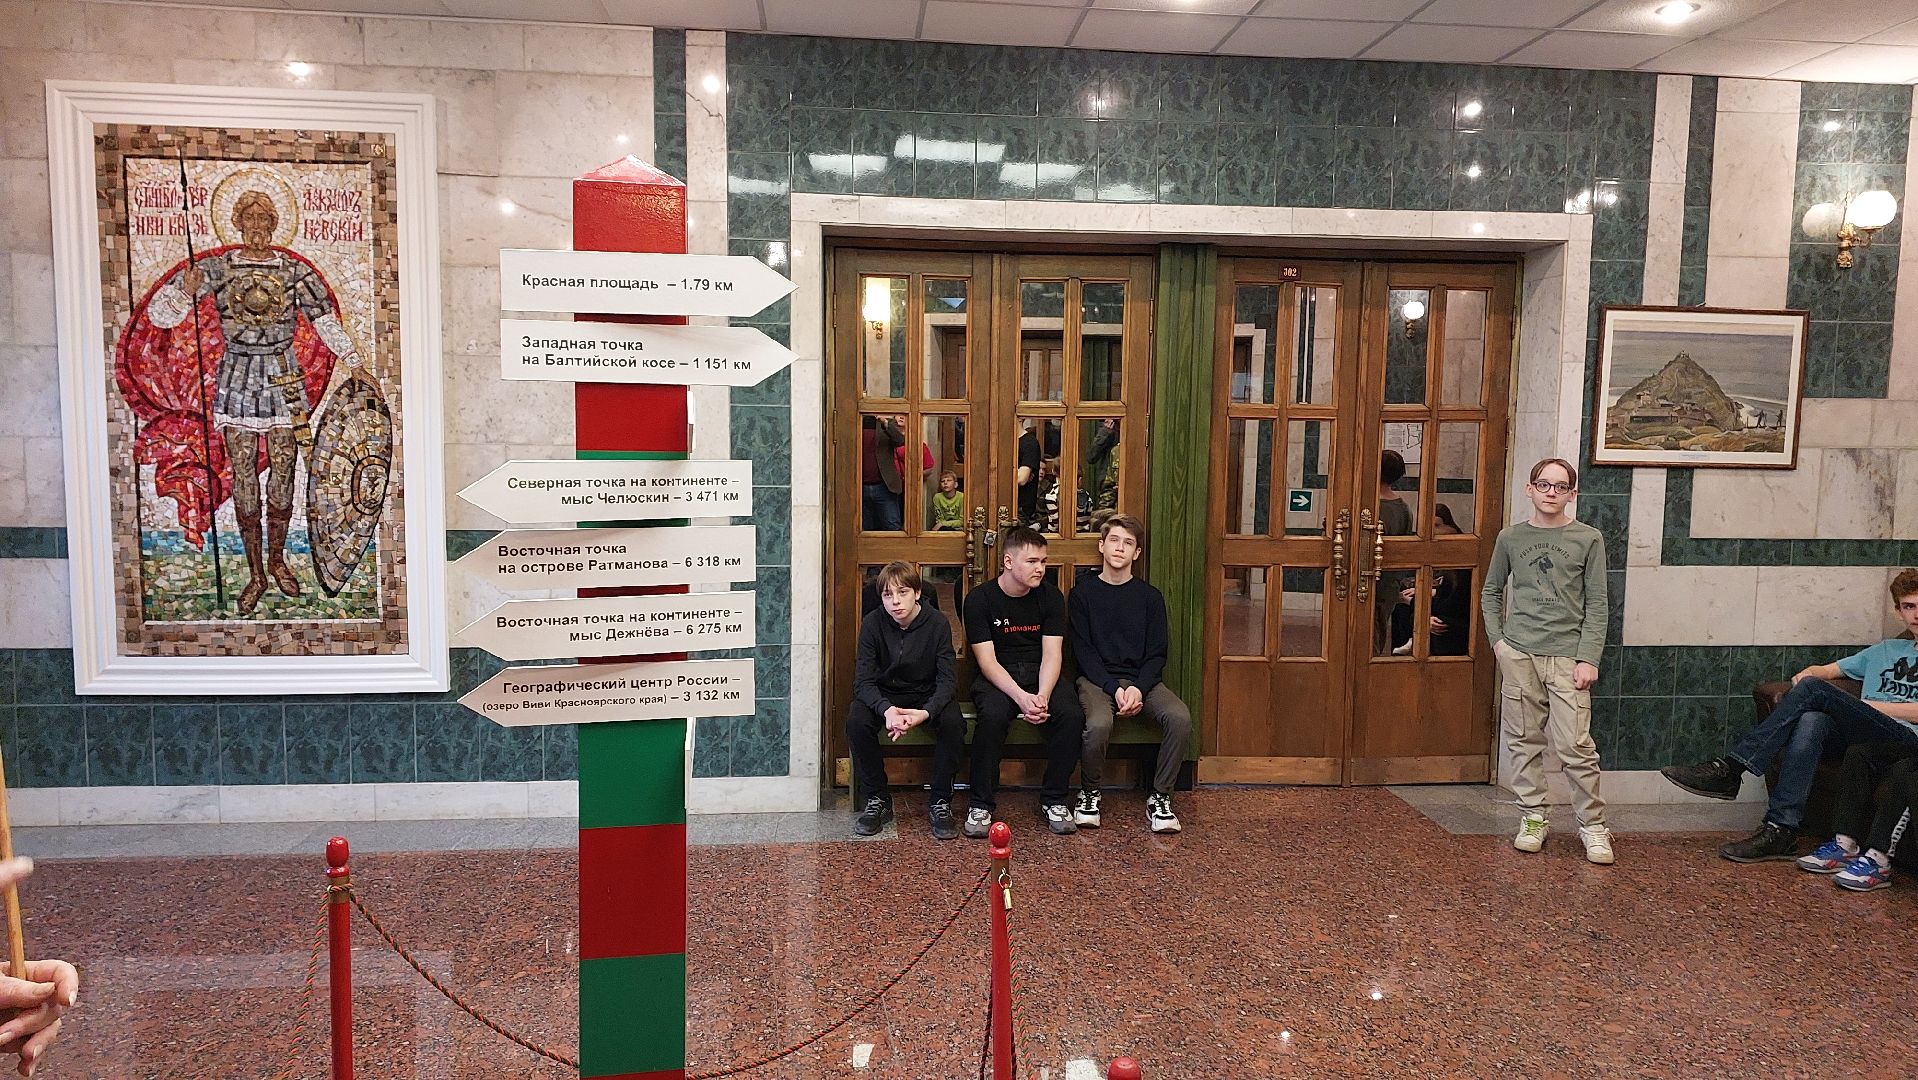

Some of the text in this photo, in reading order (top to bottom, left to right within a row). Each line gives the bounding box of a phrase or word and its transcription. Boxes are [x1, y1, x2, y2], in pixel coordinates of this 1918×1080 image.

[522, 273, 585, 290] Красная
[589, 278, 659, 292] площадь
[680, 277, 710, 291] 1.79
[714, 281, 734, 292] км
[521, 335, 645, 352] Западная точка
[522, 355, 540, 366] на
[544, 353, 637, 368] Балтийской
[642, 359, 676, 369] косе
[692, 357, 700, 369] 1
[704, 357, 727, 370] 151
[733, 361, 751, 370] км
[507, 477, 582, 492] Северная
[585, 479, 627, 490] точка
[630, 478, 647, 487] на
[649, 474, 729, 489] континенте
[561, 495, 594, 505] мыс
[597, 490, 670, 505] Челюскин
[685, 491, 693, 503] 3
[696, 490, 718, 502] 471
[723, 492, 739, 502] км
[497, 542, 627, 558] Восточная точка
[1551, 544, 1571, 559] LIMITS
[497, 562, 516, 575] на
[520, 560, 585, 576] острове
[588, 556, 669, 571] Ратманова
[684, 556, 695, 568] 6
[696, 555, 720, 568] 318
[724, 557, 741, 567] км
[496, 615, 579, 630] Восточная
[582, 614, 625, 625] точка
[629, 613, 648, 623] на
[650, 608, 731, 623] континенте
[1003, 618, 1010, 626] Я
[569, 631, 602, 642] мыс
[605, 626, 671, 642] Дежнёва
[685, 623, 694, 635] 6
[697, 622, 722, 637] 275
[725, 623, 742, 633] км
[502, 677, 627, 695] Географический
[630, 678, 673, 691] центр
[677, 674, 728, 688] России
[481, 701, 520, 714] (озеро
[522, 697, 551, 709] Виви
[554, 696, 636, 710] Красноярского
[639, 693, 668, 707] края)
[682, 690, 691, 702] 3
[695, 689, 719, 702] 132
[723, 691, 740, 700] км
